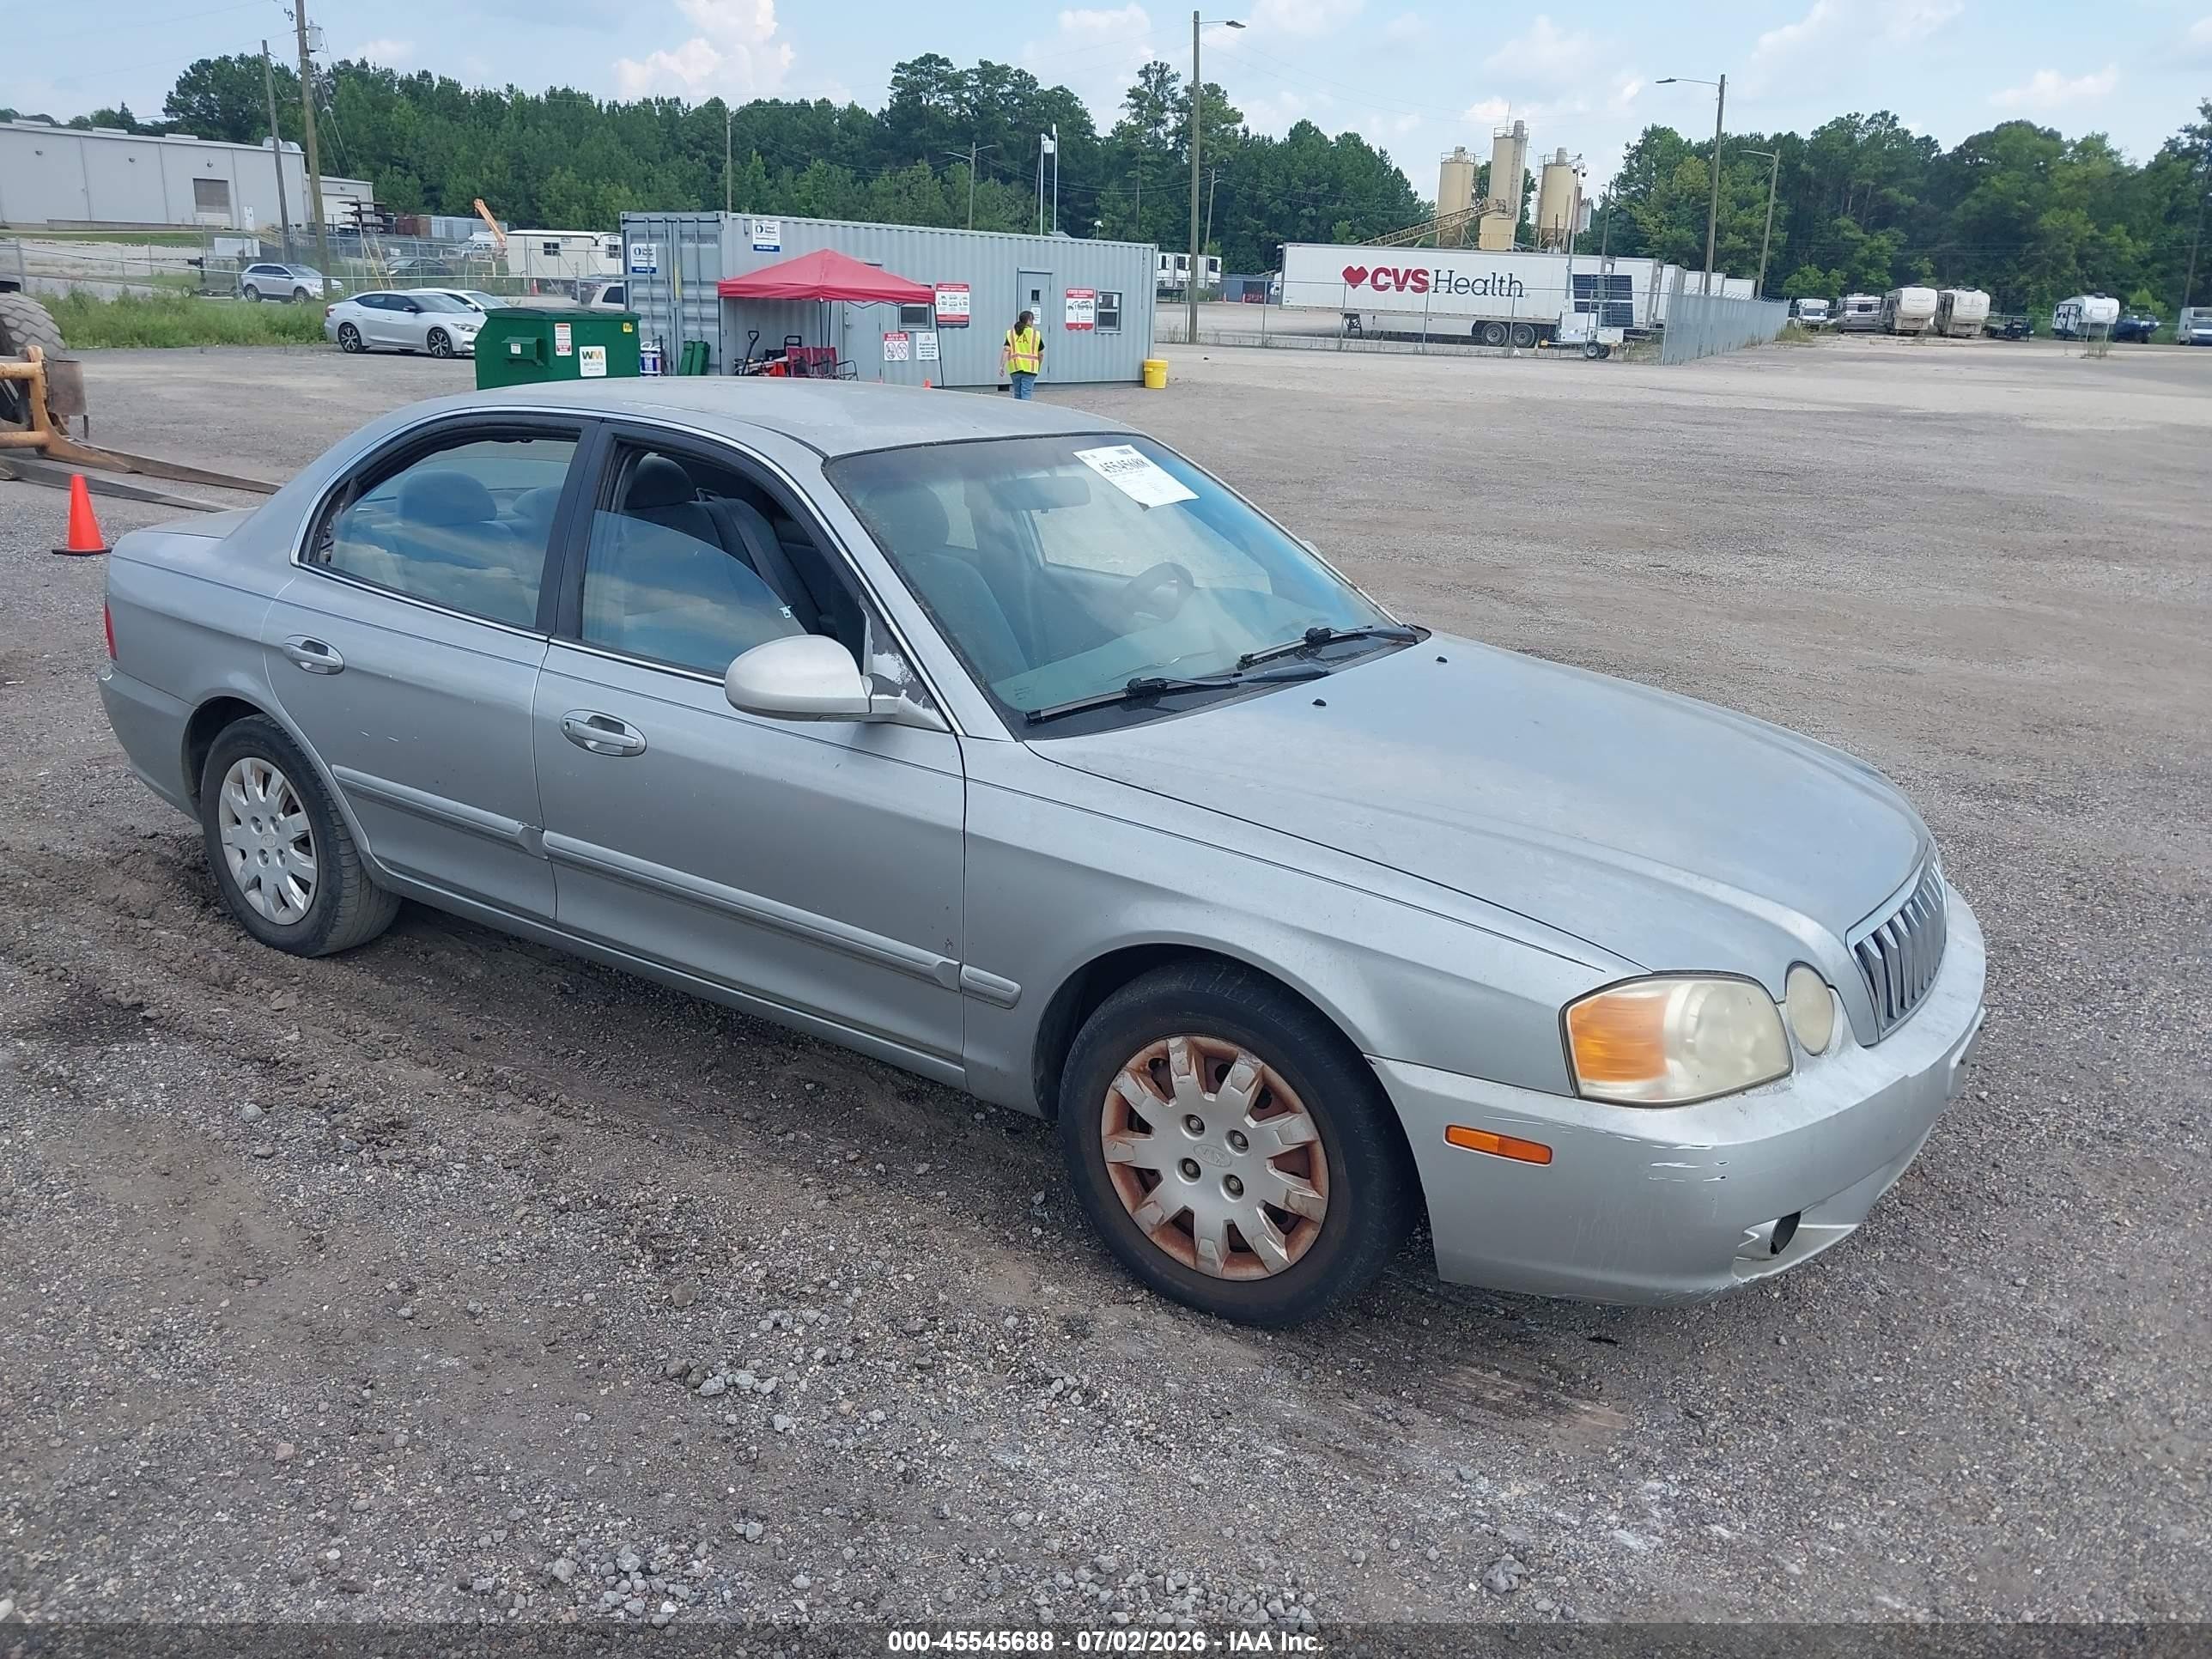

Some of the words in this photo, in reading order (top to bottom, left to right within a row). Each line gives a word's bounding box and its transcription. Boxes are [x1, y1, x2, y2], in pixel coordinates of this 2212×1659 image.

[1370, 267, 1429, 293] CVS
[1432, 270, 1524, 298] Health
[582, 350, 604, 360] WM
